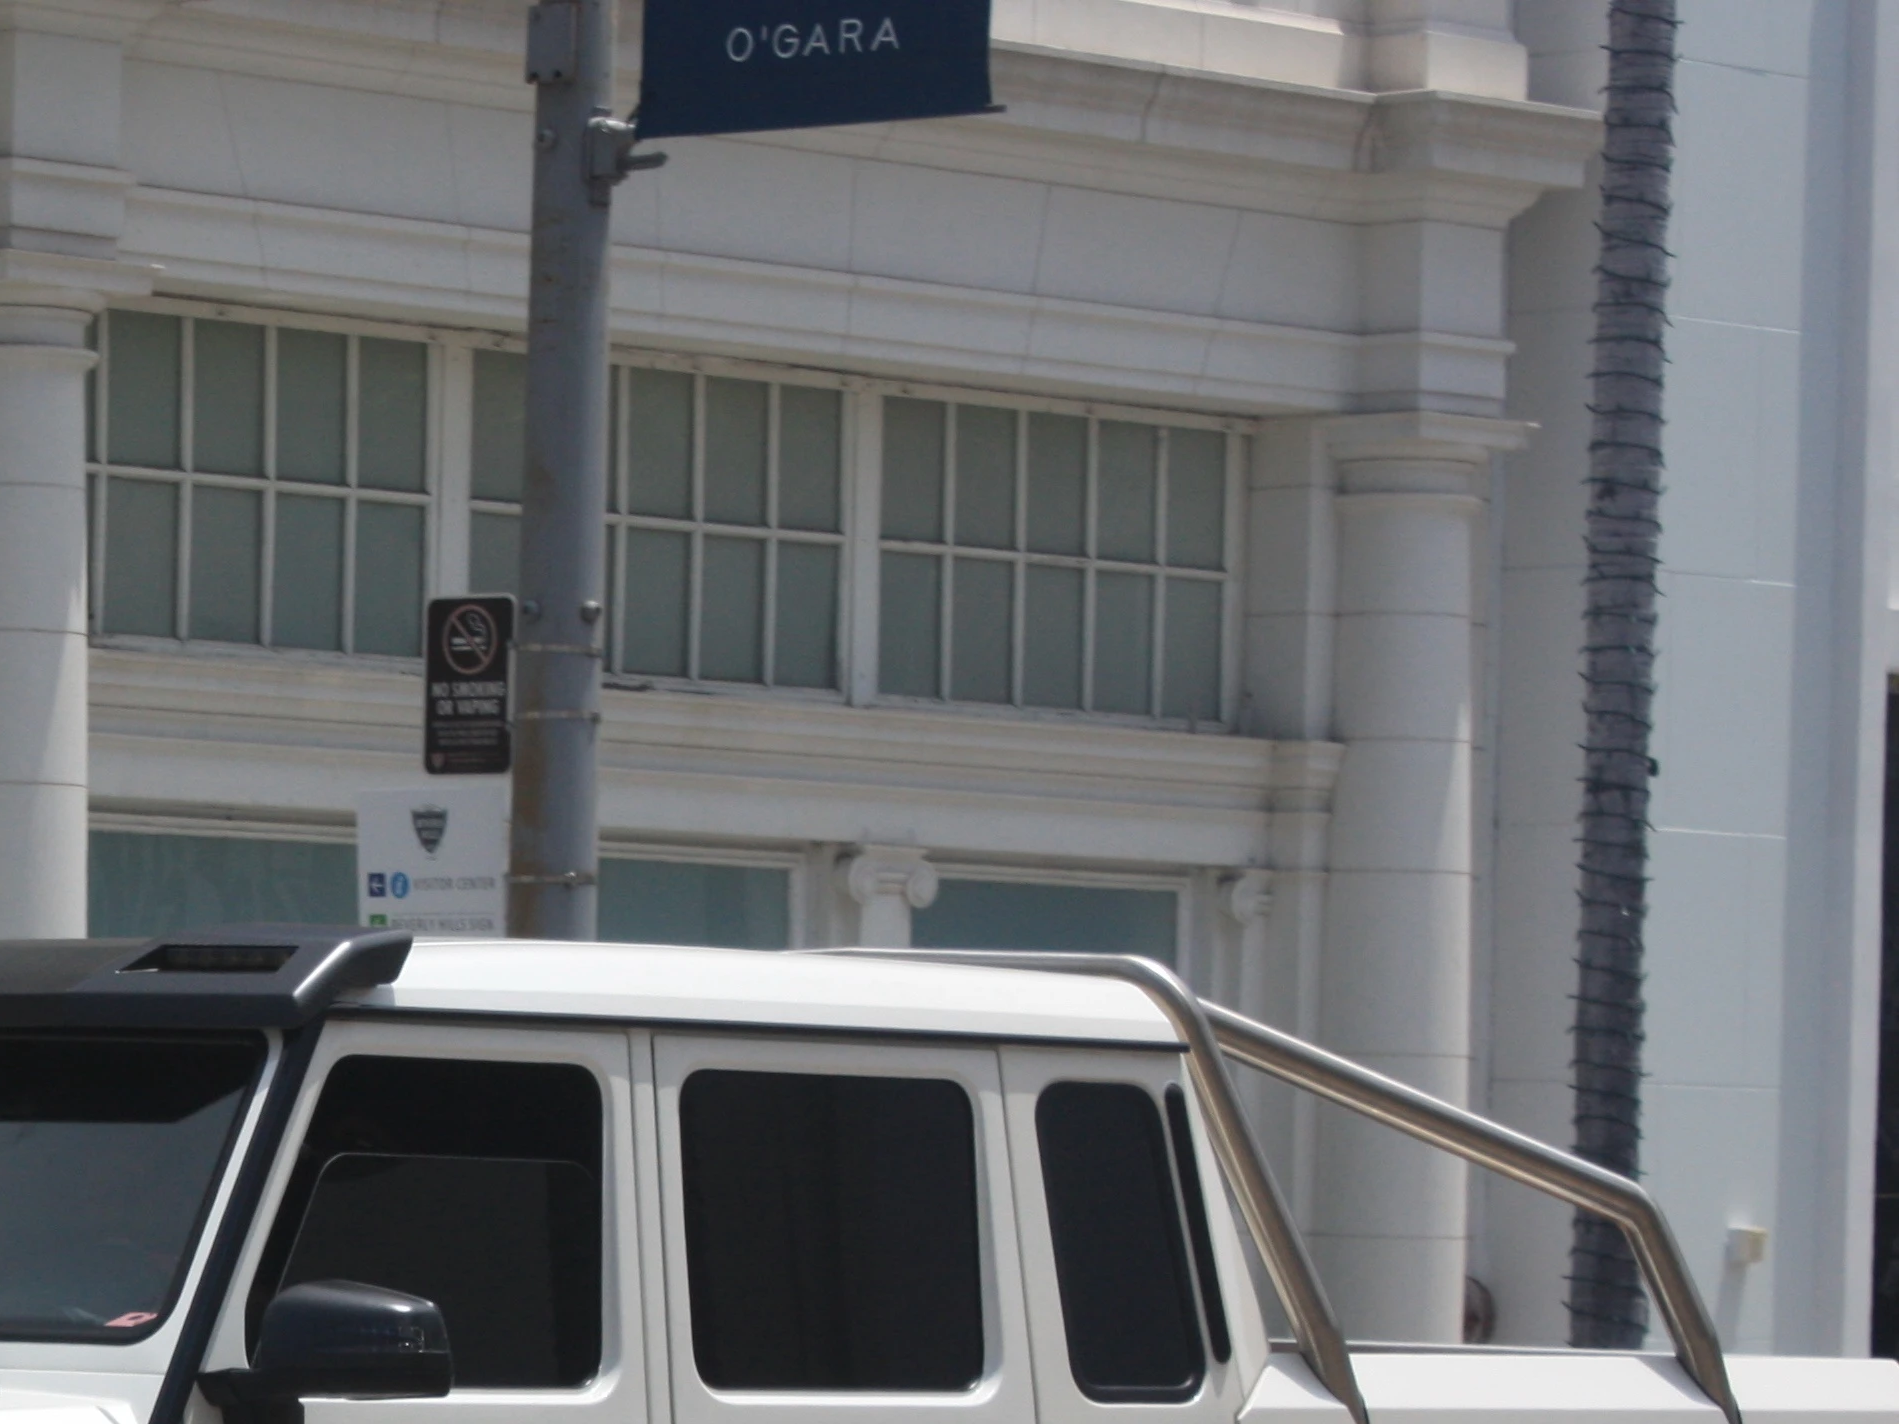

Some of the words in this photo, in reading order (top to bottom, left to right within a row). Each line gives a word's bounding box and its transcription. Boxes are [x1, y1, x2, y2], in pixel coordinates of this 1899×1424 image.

[726, 17, 900, 63] O'GARA
[431, 682, 450, 697] NO
[452, 681, 506, 697] SMOKING
[436, 699, 454, 715] OR
[456, 699, 500, 715] VAPING
